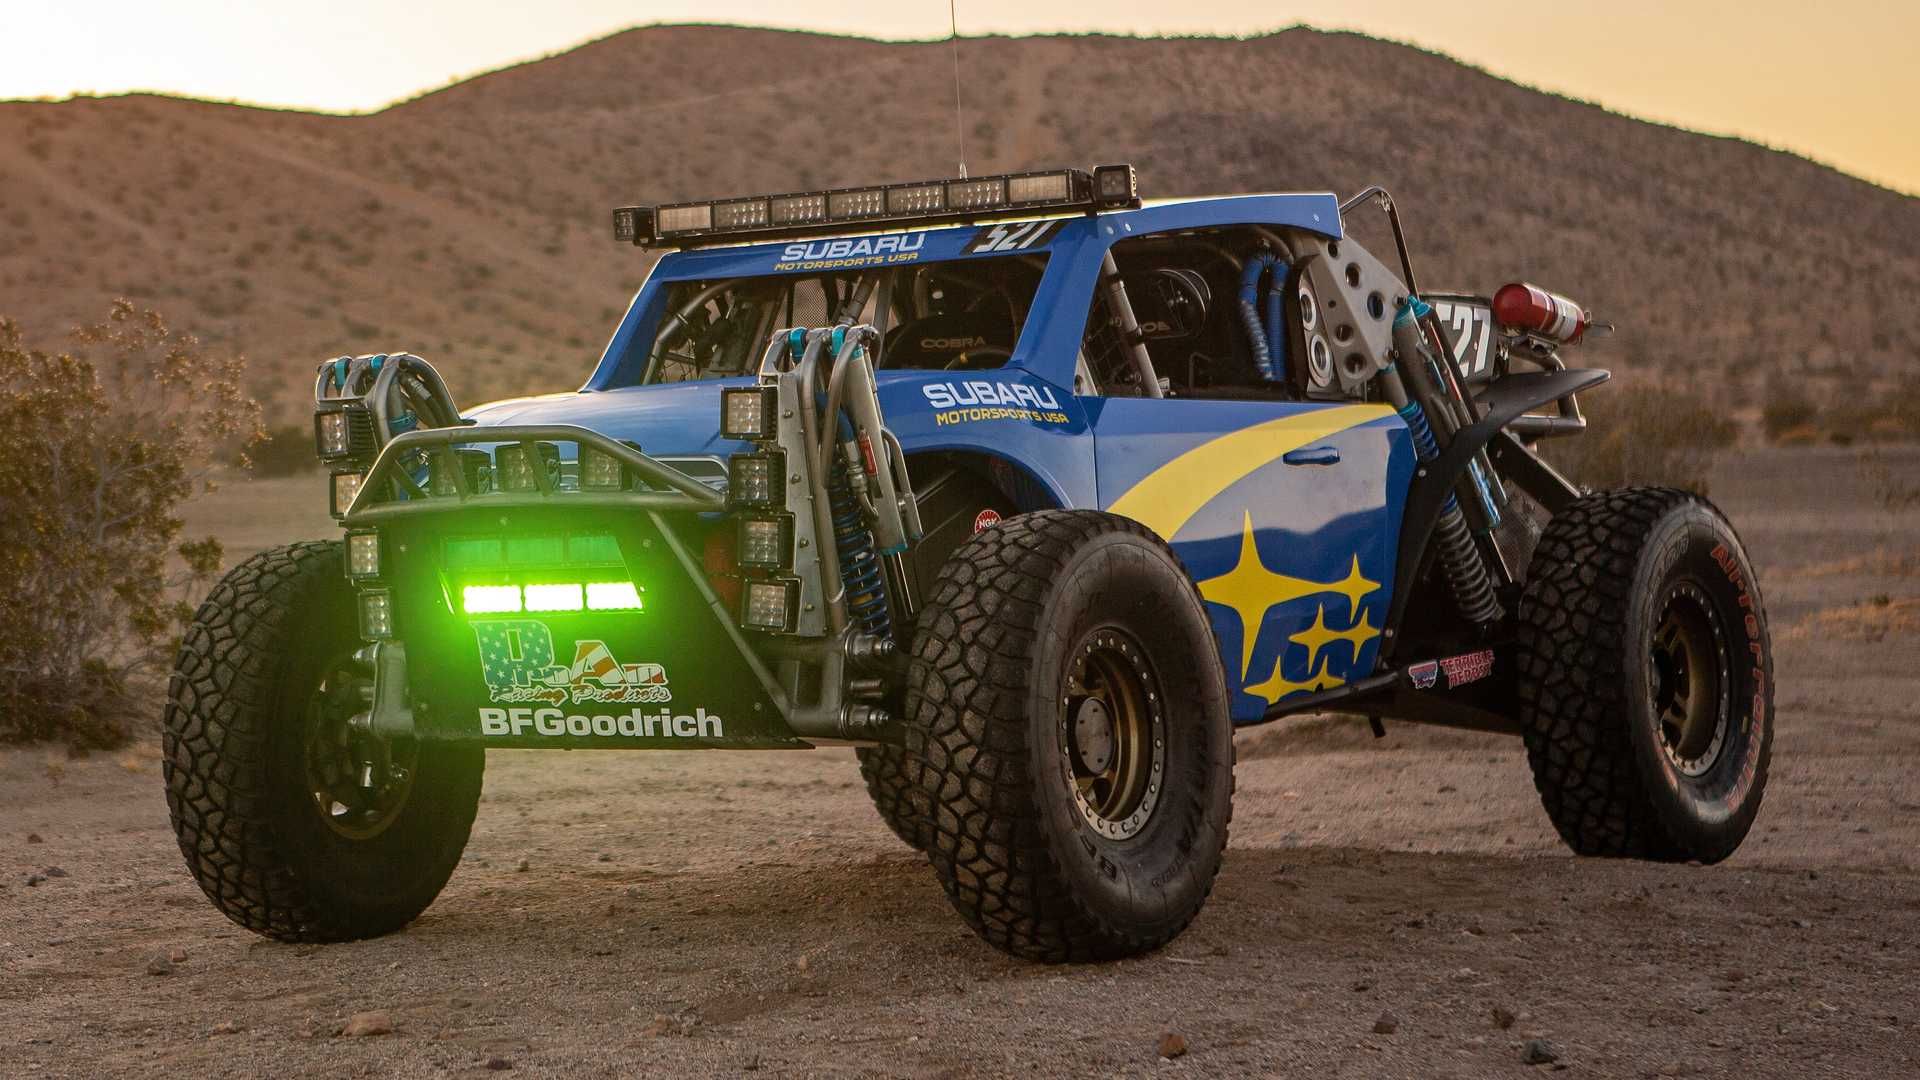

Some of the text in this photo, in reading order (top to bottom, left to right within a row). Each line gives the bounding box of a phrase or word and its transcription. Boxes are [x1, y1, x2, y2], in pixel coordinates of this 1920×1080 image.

[780, 233, 925, 262] SUBARU
[774, 252, 918, 271] MOTORSPORTS USA
[921, 335, 985, 349] COBRA
[1435, 303, 1491, 377] 27
[922, 381, 1059, 410] SUBARU
[936, 408, 1070, 426] MOTORSPORTS USA
[490, 683, 672, 707] Racing Products
[479, 708, 723, 738] BFGoodrich
